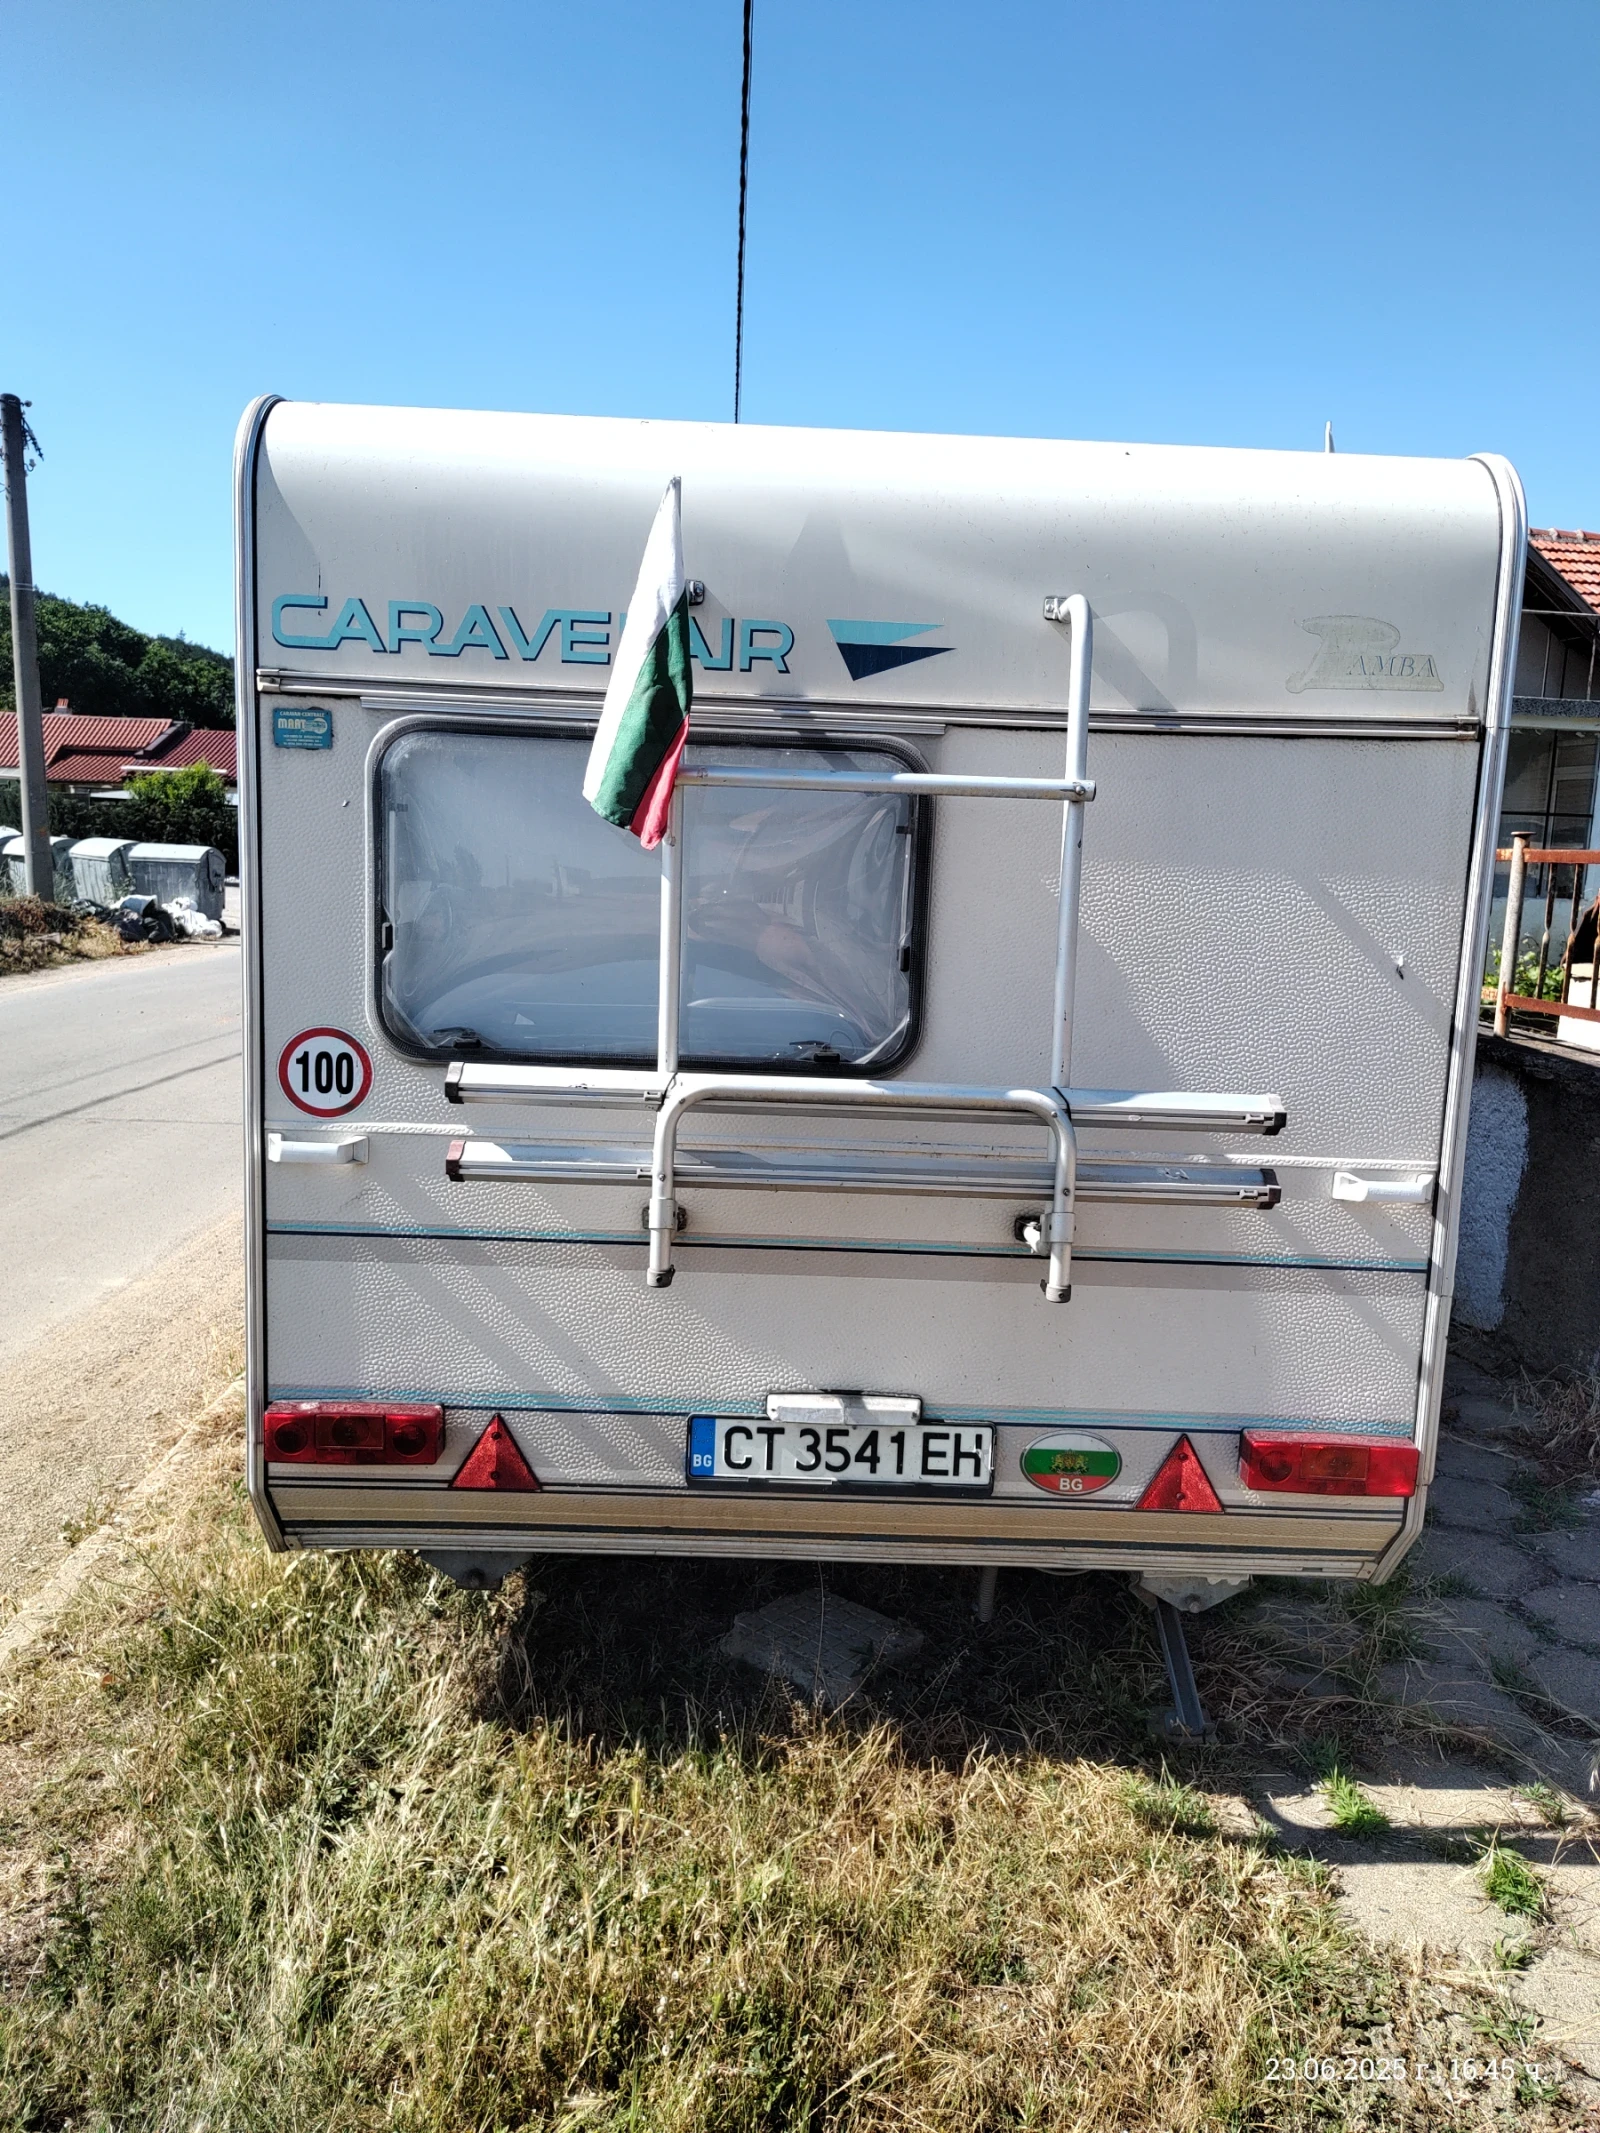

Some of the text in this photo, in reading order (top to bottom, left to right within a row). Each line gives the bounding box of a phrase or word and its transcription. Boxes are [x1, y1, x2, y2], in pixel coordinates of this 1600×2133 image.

[272, 594, 795, 675] CARAVEAIR
[296, 1051, 354, 1094] 100
[693, 1454, 713, 1468] BG
[796, 1428, 906, 1475] 3541
[1060, 1478, 1083, 1491] BG
